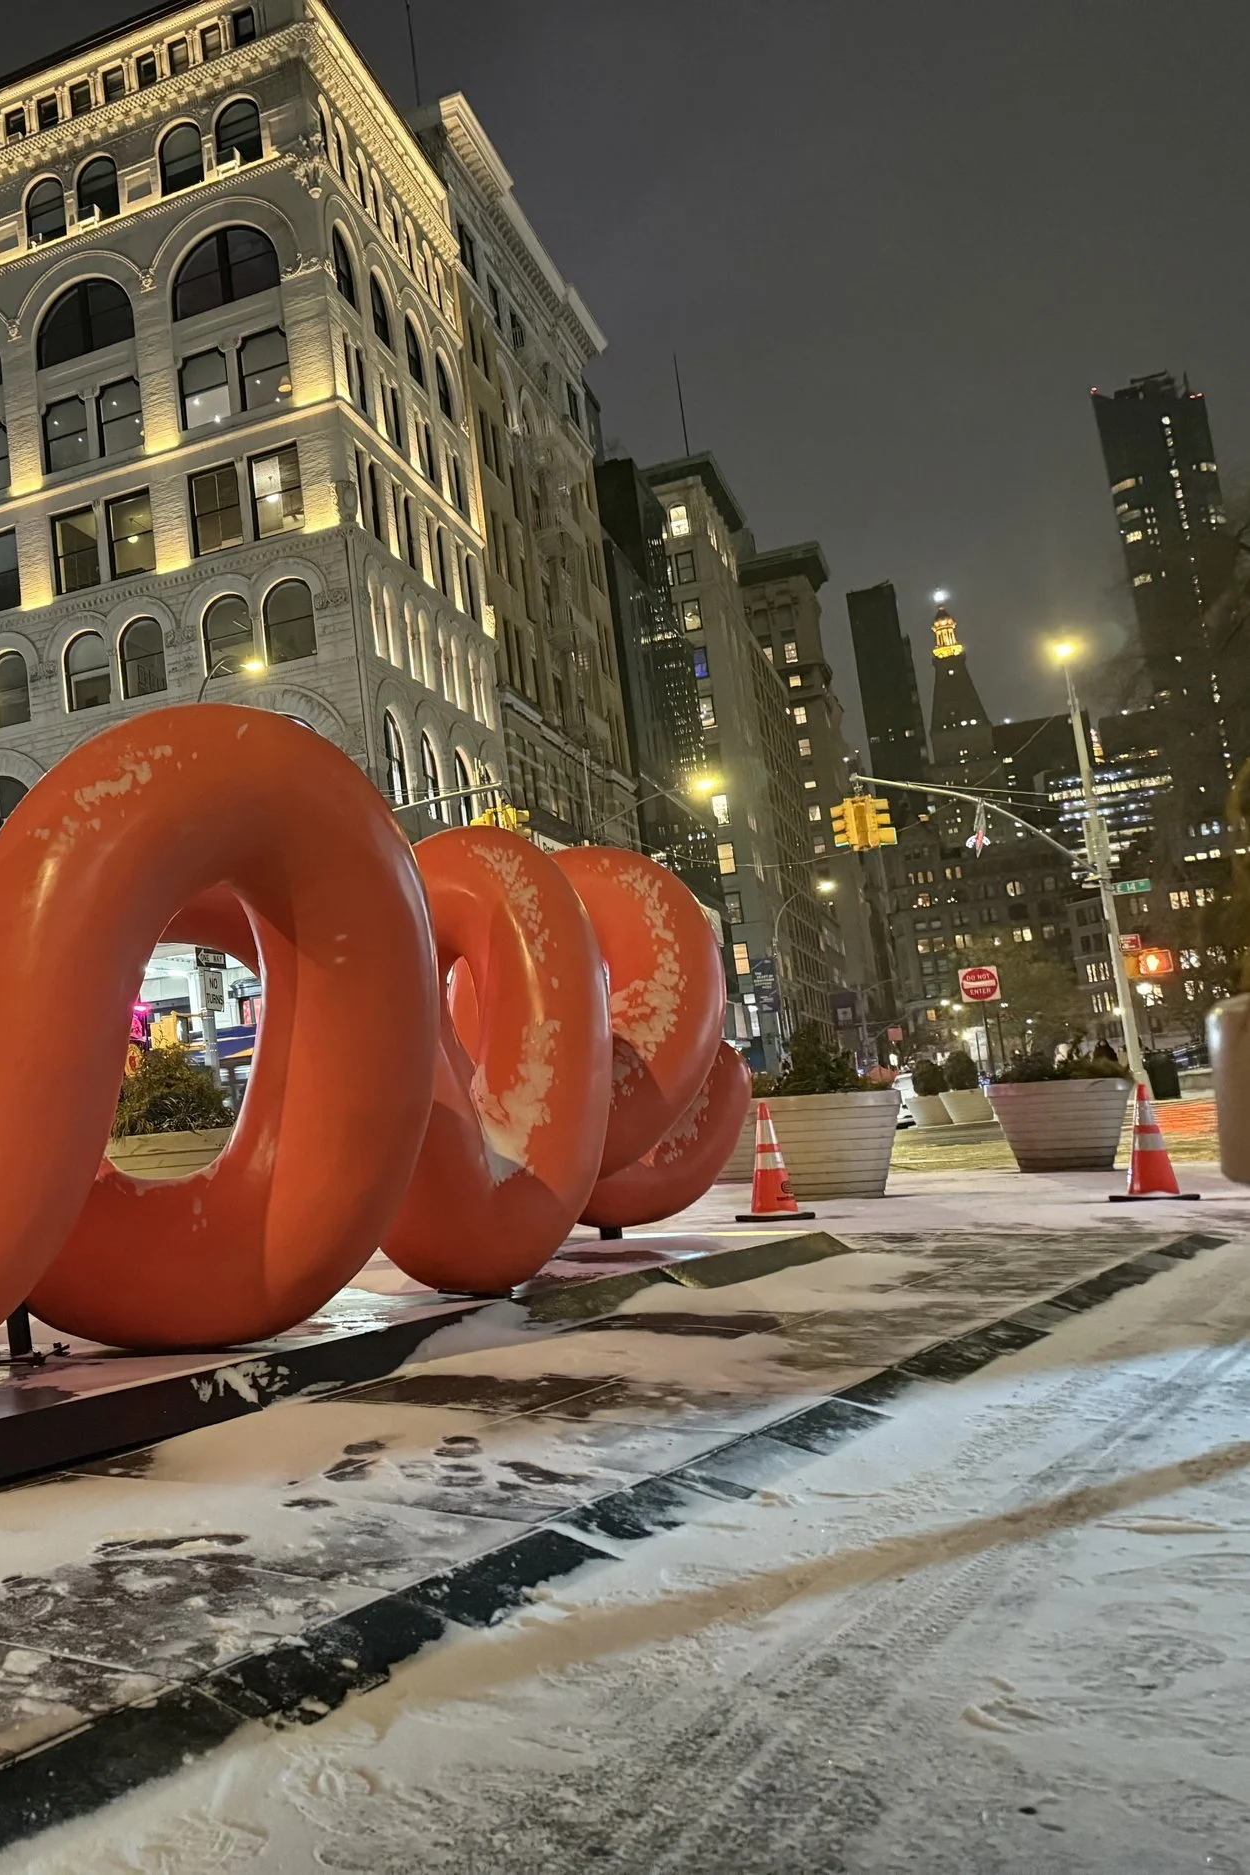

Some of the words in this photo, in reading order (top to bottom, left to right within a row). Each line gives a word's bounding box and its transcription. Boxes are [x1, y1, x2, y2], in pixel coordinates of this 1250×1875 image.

[1126, 881, 1137, 892] 14
[200, 953, 210, 962] ONE
[213, 955, 223, 963] WAY
[966, 974, 976, 982] DO
[977, 973, 991, 981] NOT
[208, 977, 218, 989] NO
[969, 987, 991, 996] ENTER
[206, 992, 224, 1006] TURNS
